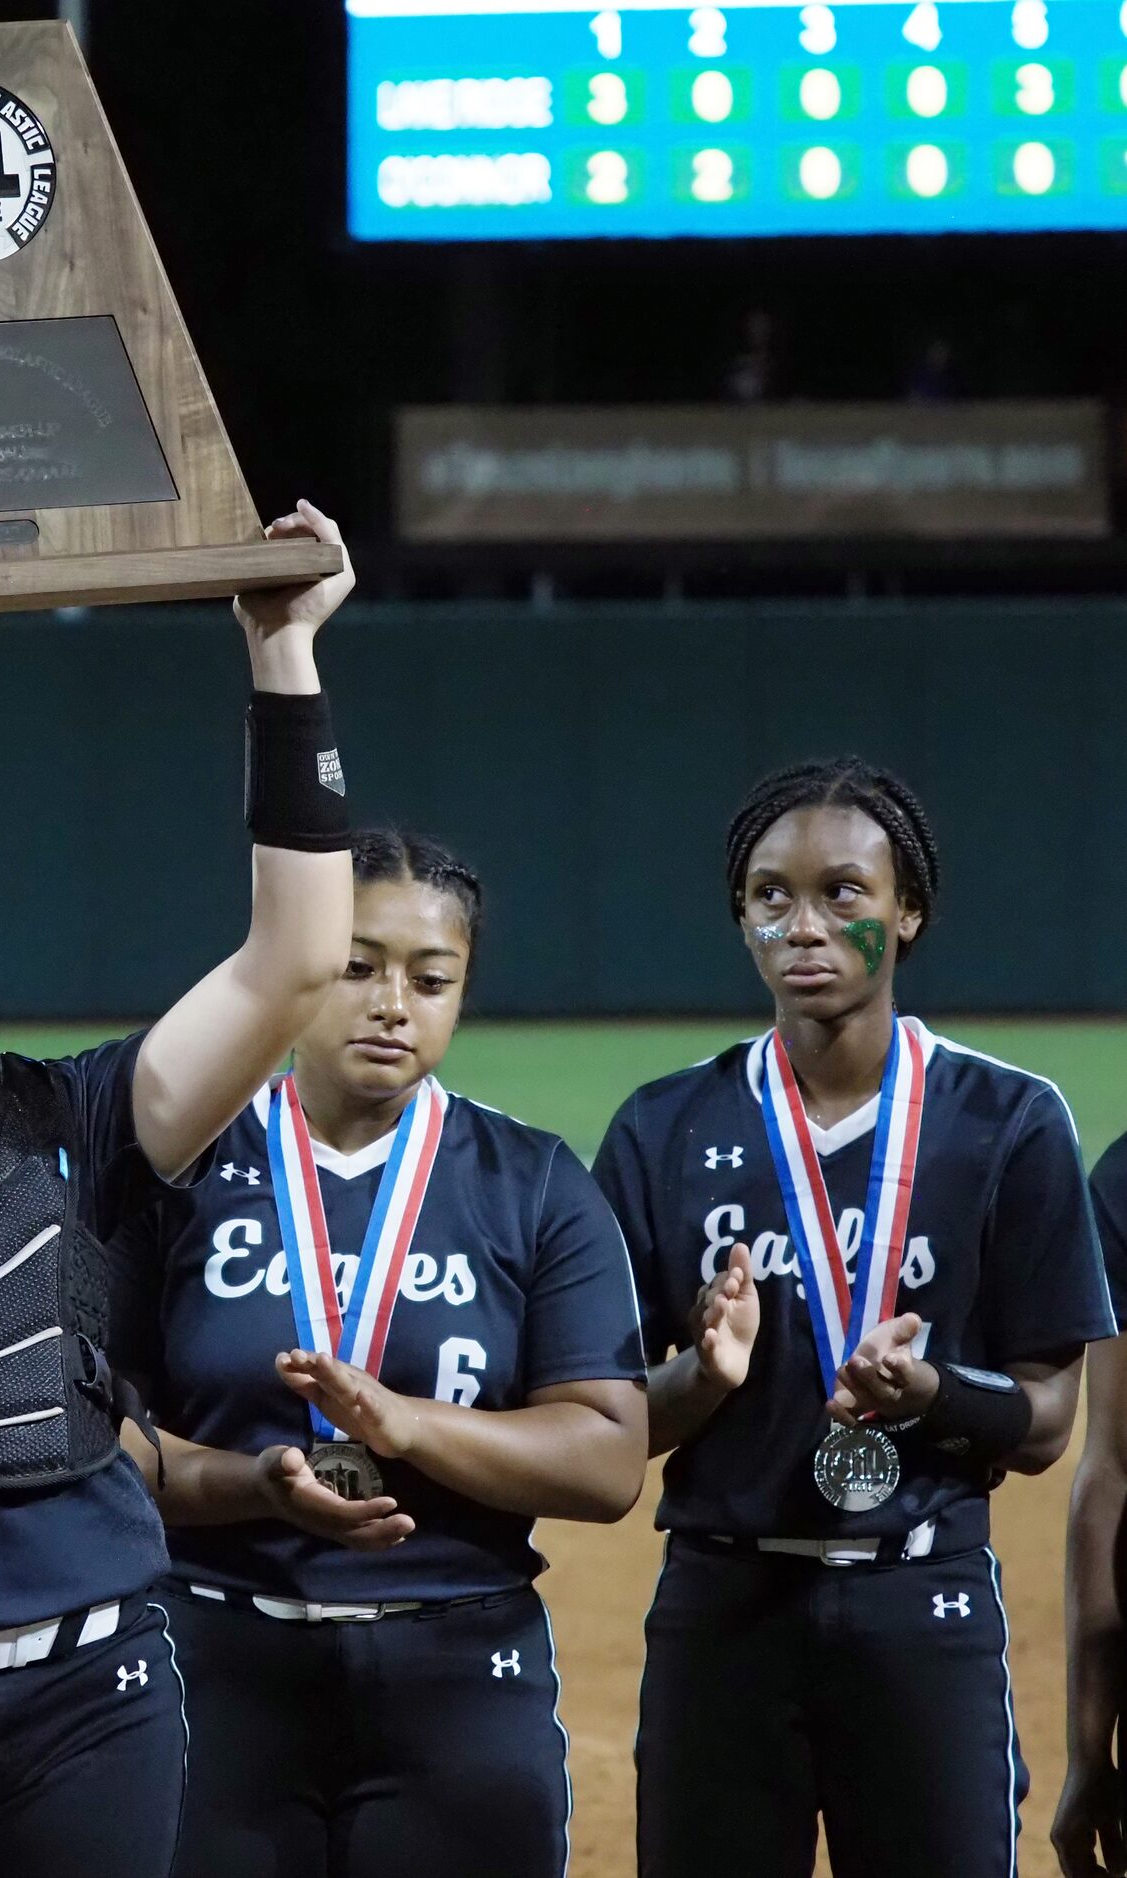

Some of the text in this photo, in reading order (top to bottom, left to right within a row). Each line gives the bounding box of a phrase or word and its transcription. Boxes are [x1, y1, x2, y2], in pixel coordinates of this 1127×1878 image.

[589, 10, 622, 59] 1
[688, 7, 727, 57] 2
[799, 4, 836, 54] 3
[902, 1, 942, 51] 4
[587, 73, 627, 124] 3
[692, 71, 732, 122] 0
[800, 68, 840, 120] 0
[907, 66, 947, 117] 0
[1015, 63, 1054, 115] 3
[12, 167, 52, 242] LEAGUE
[587, 151, 627, 203] 2
[692, 149, 732, 201] 2
[800, 147, 841, 198] 0
[907, 145, 947, 197] 0
[1014, 142, 1054, 194] 0
[319, 758, 341, 774] ZON
[203, 1218, 477, 1315] Eages
[700, 1203, 936, 1299] Eals
[434, 1336, 487, 1408] 6
